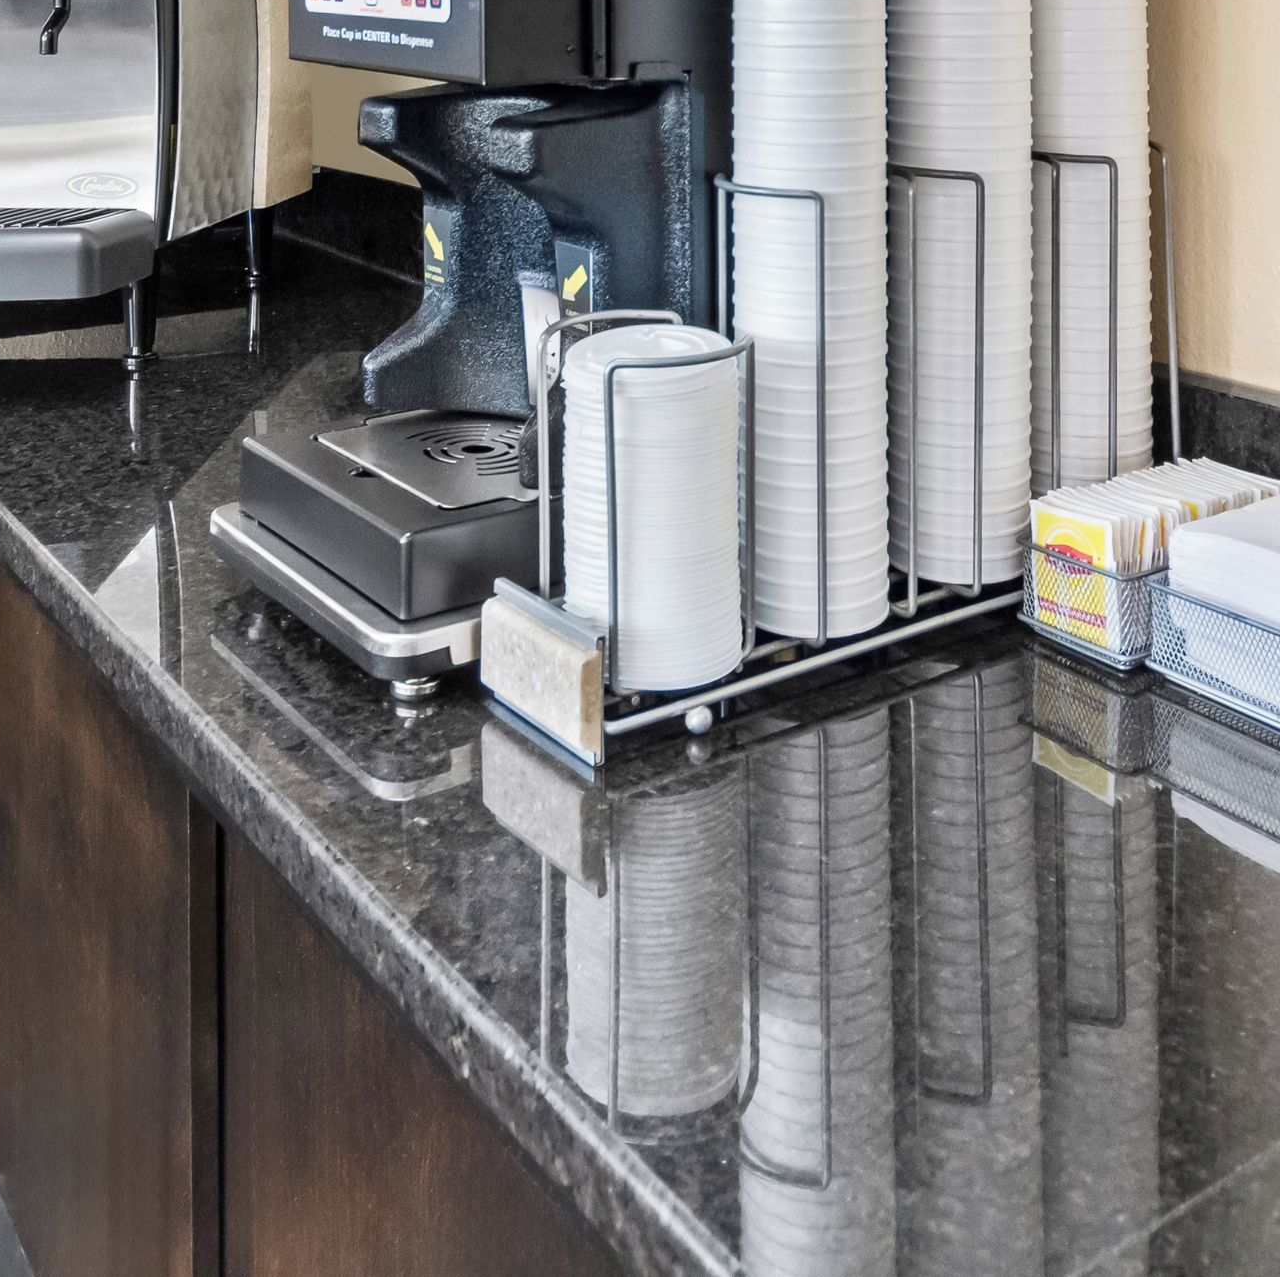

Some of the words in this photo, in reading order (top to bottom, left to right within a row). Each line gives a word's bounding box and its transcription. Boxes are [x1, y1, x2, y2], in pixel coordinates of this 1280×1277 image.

[322, 25, 340, 39] Place
[341, 27, 354, 42] Cup
[354, 28, 361, 40] in
[362, 29, 390, 44] CENTER
[391, 32, 399, 45] to
[400, 33, 434, 49] Dispense
